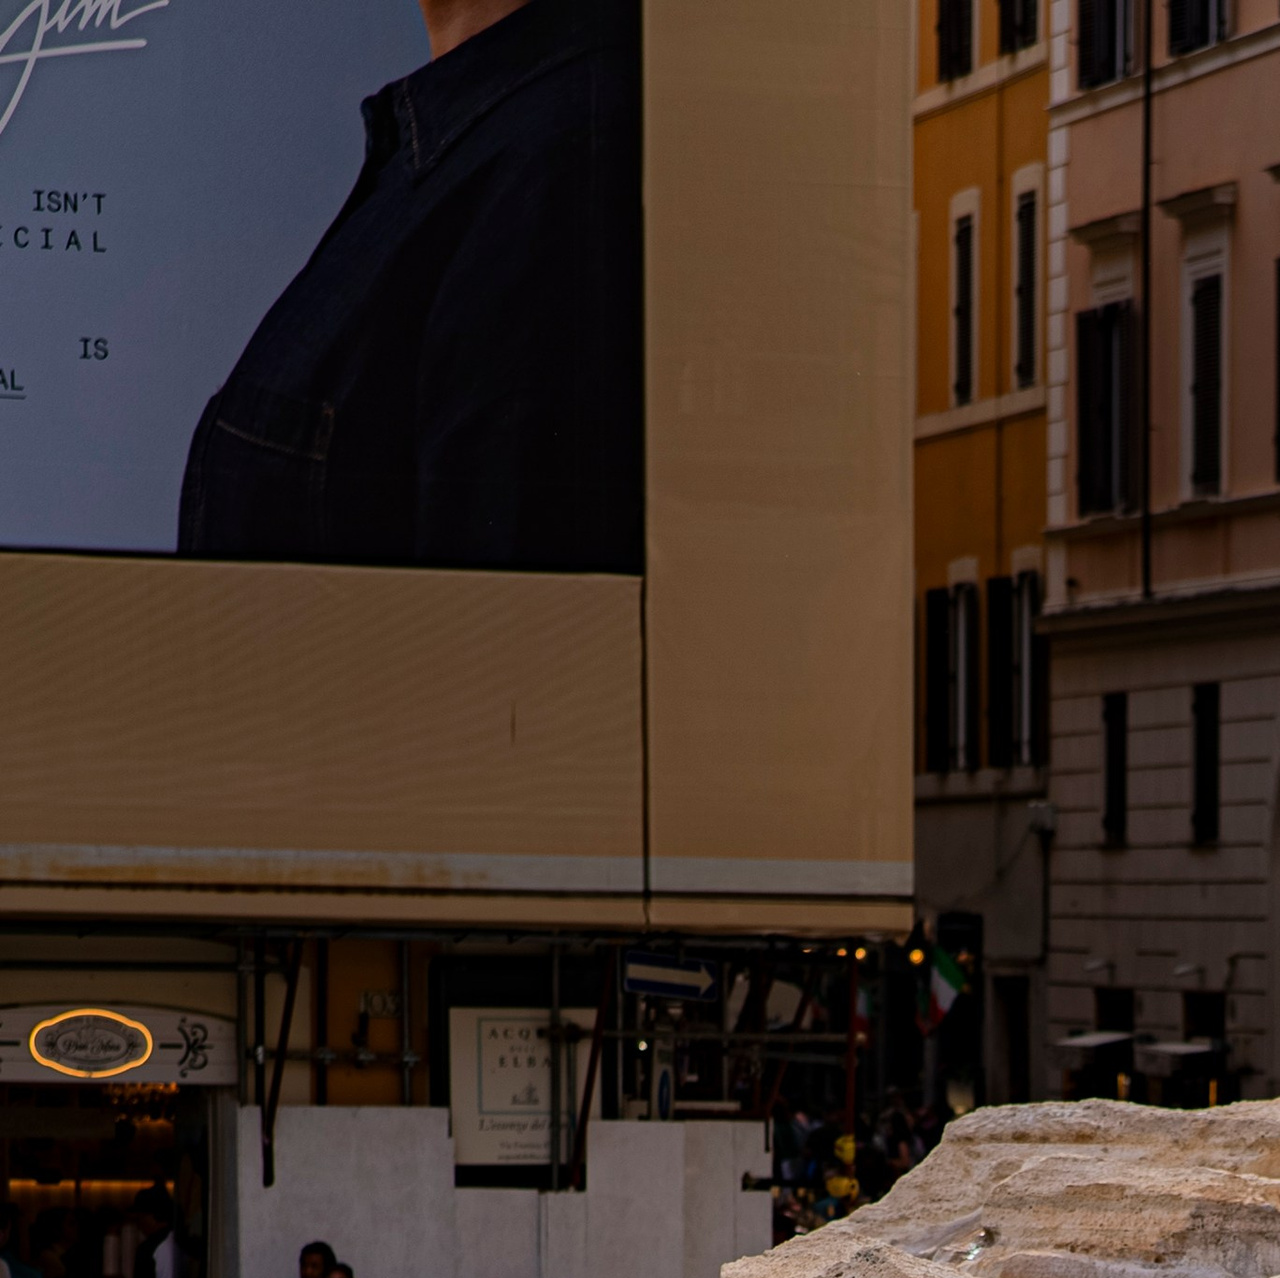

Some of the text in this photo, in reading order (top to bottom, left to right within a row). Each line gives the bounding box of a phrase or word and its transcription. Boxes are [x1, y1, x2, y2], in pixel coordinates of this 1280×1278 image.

[32, 189, 107, 216] ISN'T
[0, 225, 107, 253] CIAL
[79, 337, 110, 361] IS
